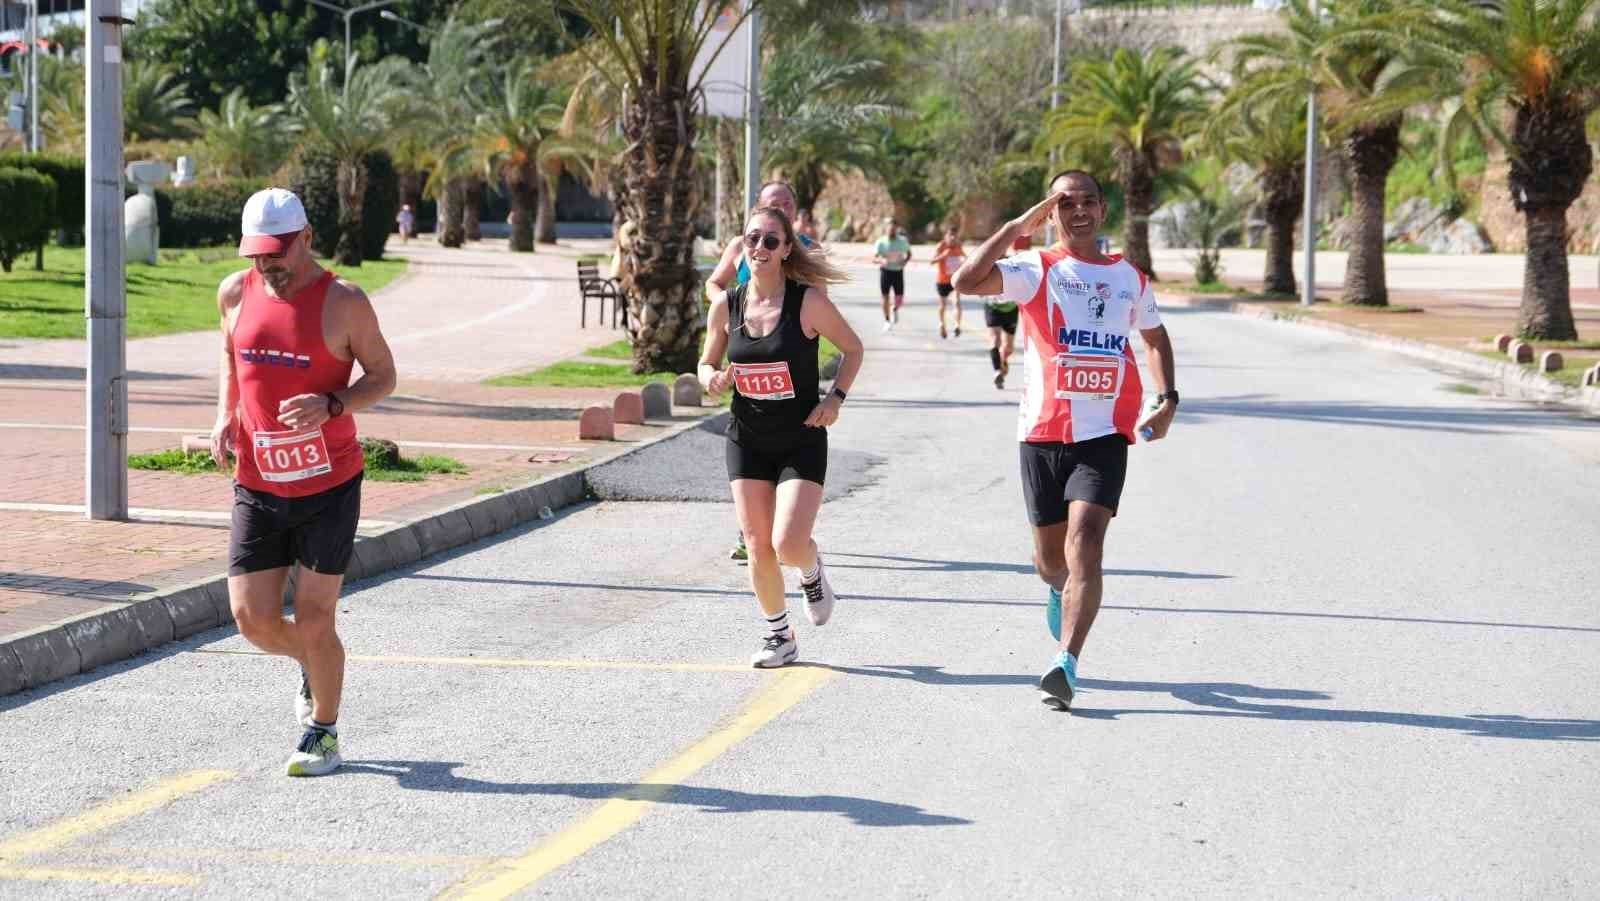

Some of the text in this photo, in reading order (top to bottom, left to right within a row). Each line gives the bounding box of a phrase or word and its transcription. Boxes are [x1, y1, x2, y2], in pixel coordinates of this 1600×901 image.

[742, 375, 785, 392] 1113
[1064, 369, 1113, 390] 1095
[262, 444, 320, 470] 1013
